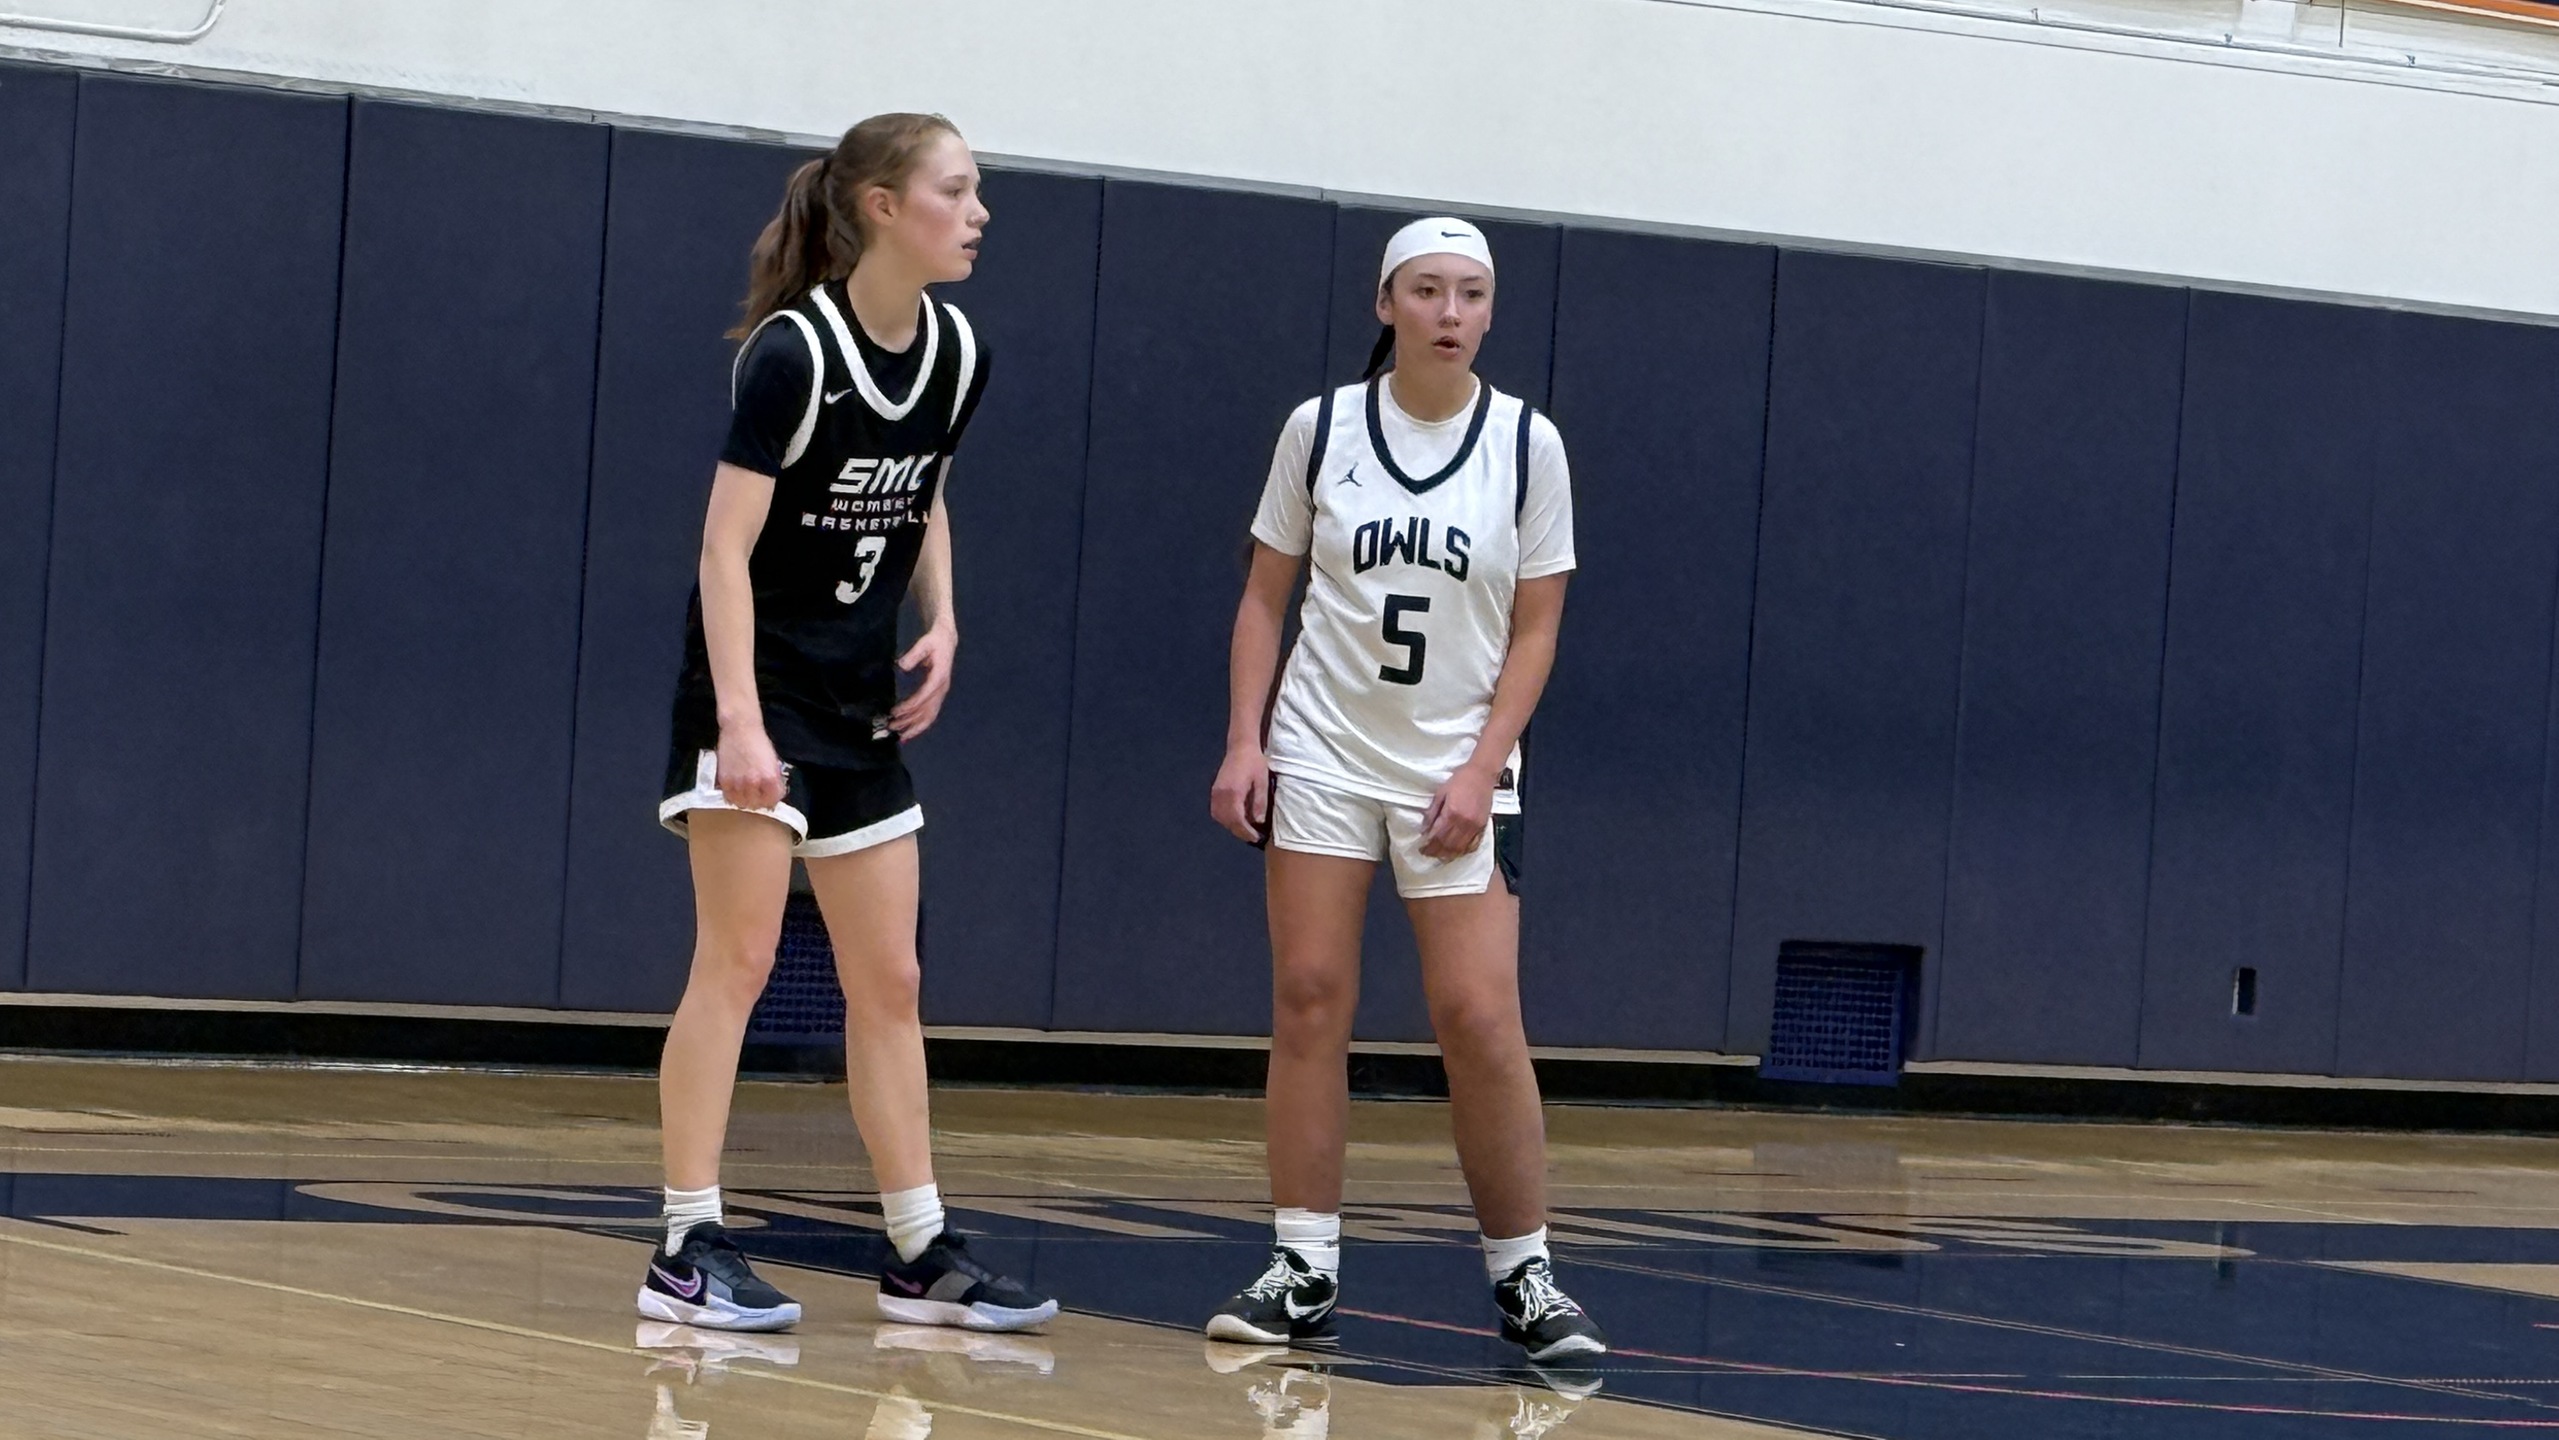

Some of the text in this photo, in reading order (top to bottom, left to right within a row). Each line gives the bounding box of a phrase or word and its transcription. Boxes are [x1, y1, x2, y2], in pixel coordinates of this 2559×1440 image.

[829, 452, 938, 494] SMC
[801, 510, 930, 531] BASKETL
[1353, 516, 1471, 582] OWLS
[835, 536, 887, 604] 3
[1378, 594, 1431, 685] 5
